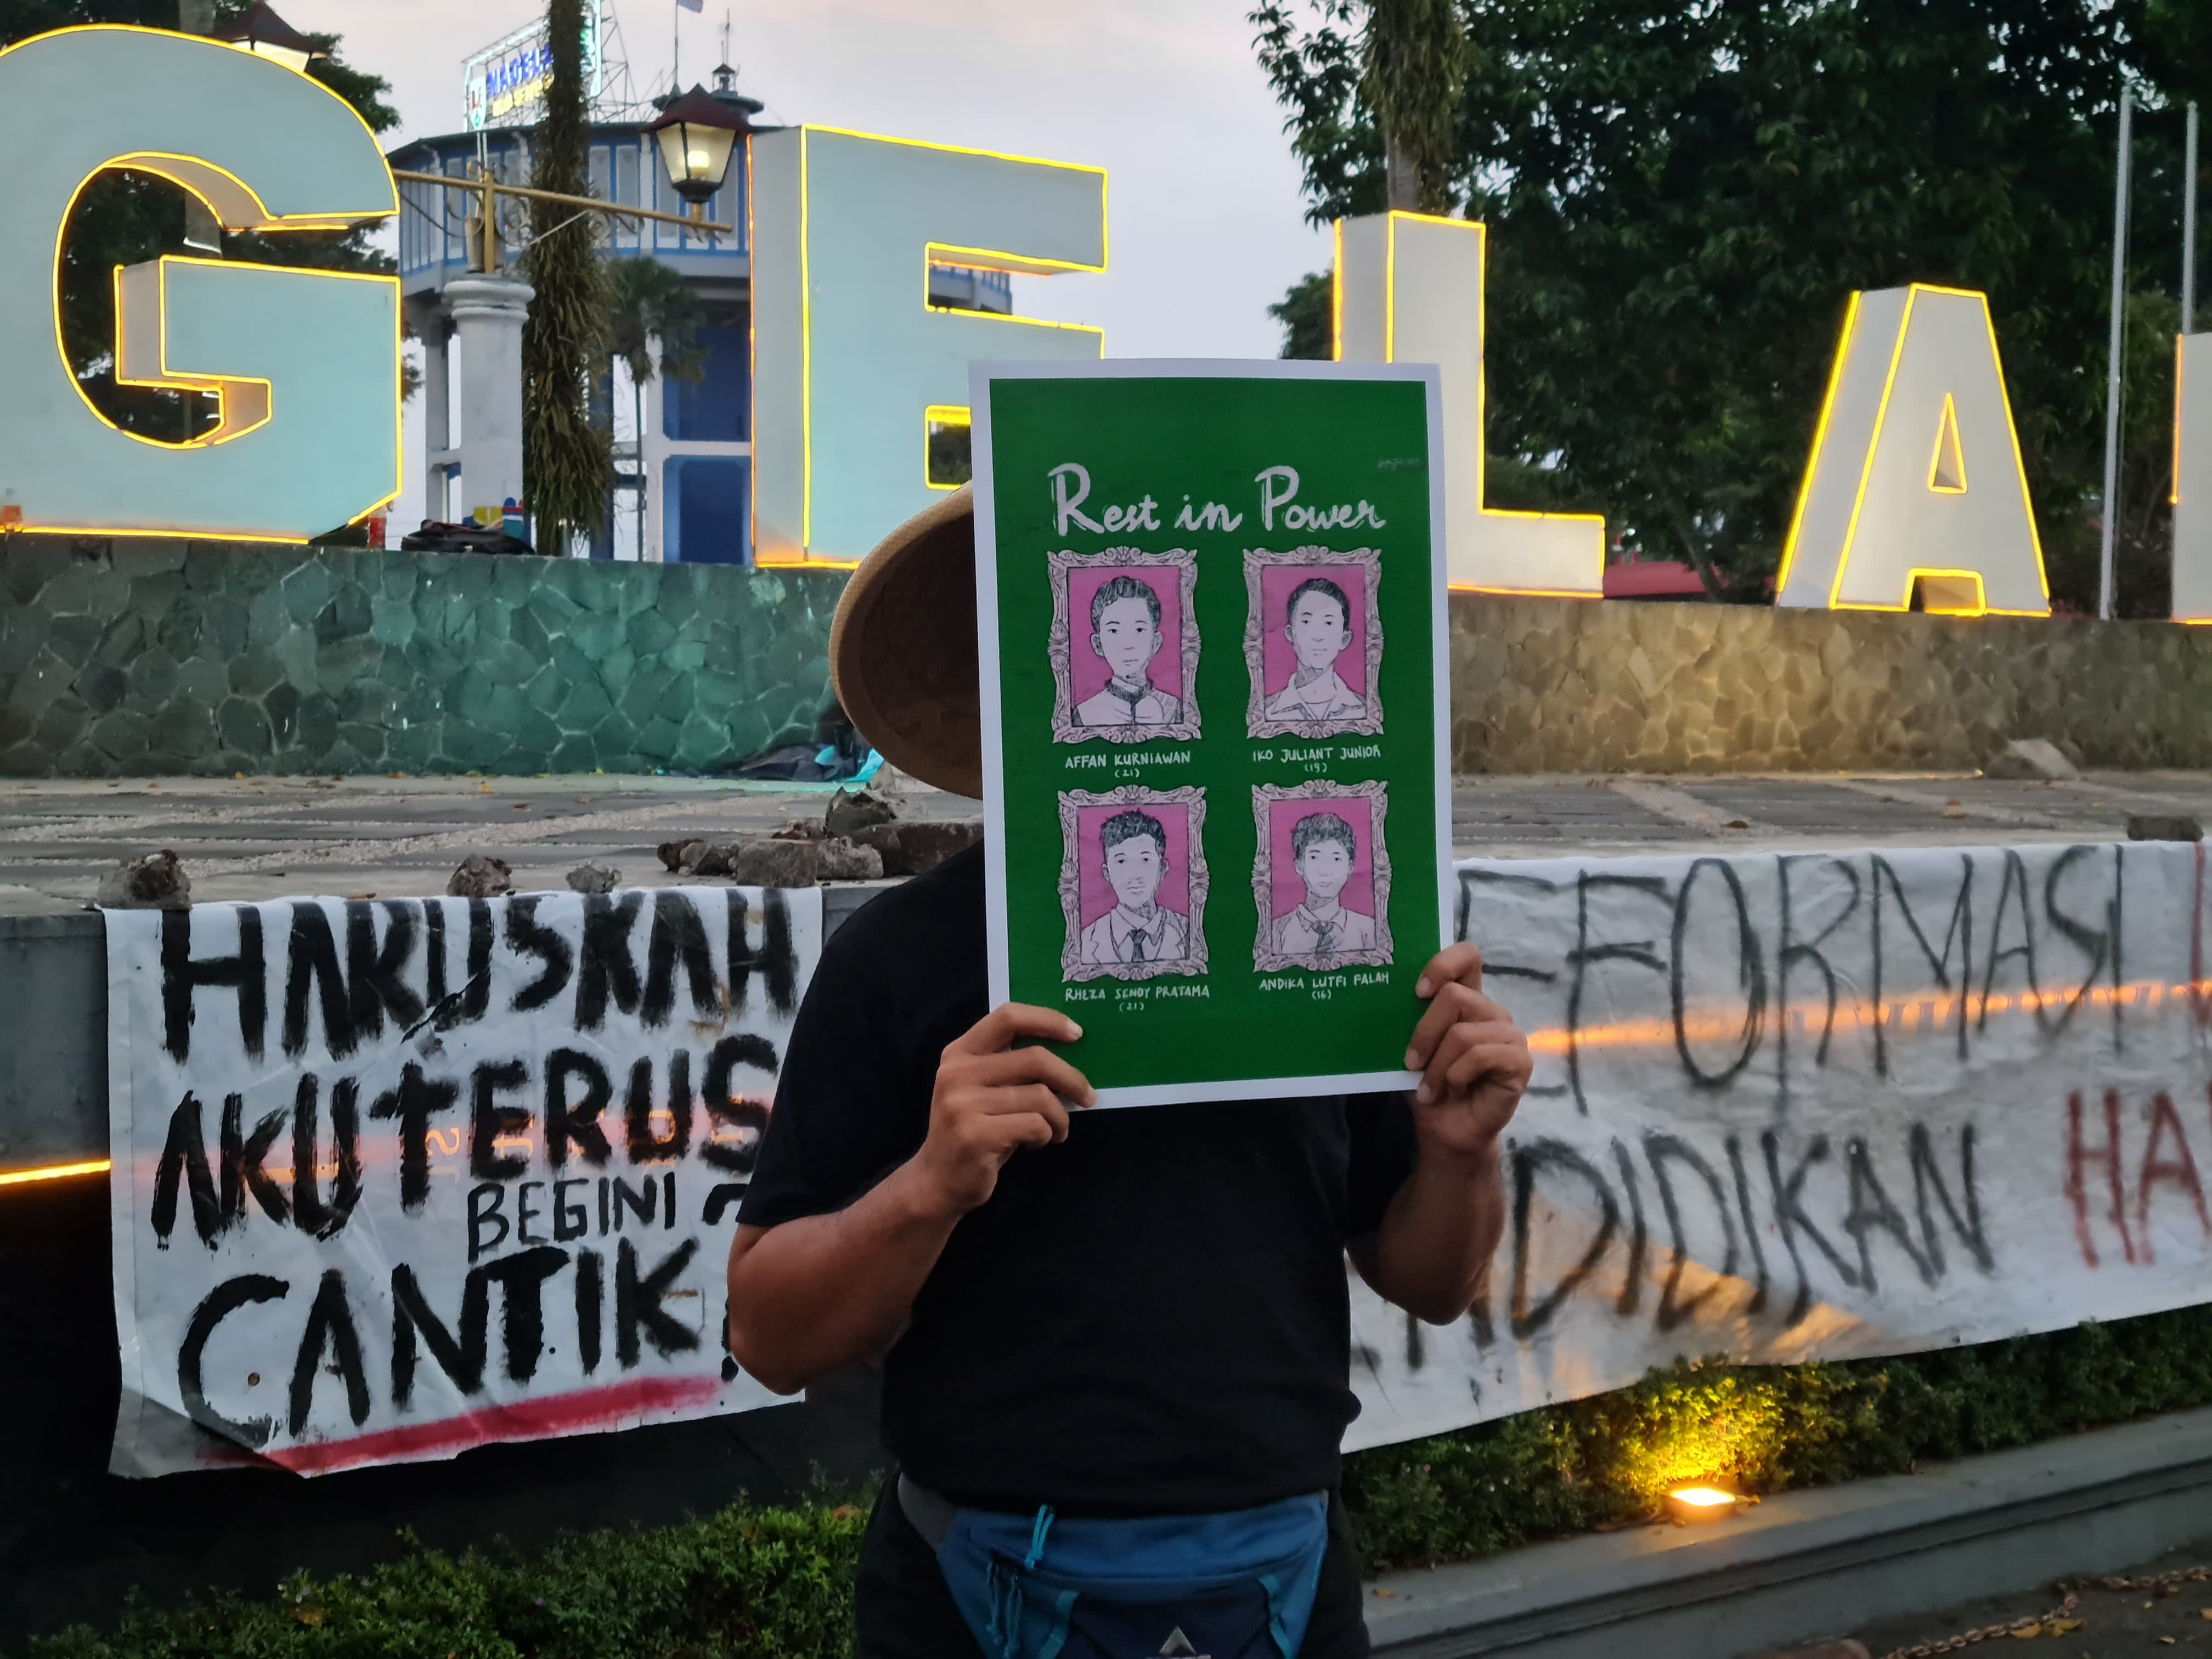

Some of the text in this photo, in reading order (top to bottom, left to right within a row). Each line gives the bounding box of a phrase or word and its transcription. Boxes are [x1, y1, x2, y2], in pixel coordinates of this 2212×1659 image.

[1048, 462, 1387, 537] Rest in Power
[1065, 751, 1190, 769] AFFAN KURNIAWAN
[1252, 744, 1381, 763] IKO JULIANT JUNIOR
[1114, 769, 1140, 778] (21)
[1259, 972, 1390, 991] ANDIKA LUTFI FALAH
[1457, 844, 2123, 1116] EFORMASI
[1065, 985, 1210, 1001] RHEZA SENDY PRATAMA
[1312, 989, 1332, 1000] (16)
[1119, 1002, 1144, 1012] (21)
[2066, 1081, 2212, 1271] HA
[467, 1172, 676, 1265] BEGINI
[177, 1237, 700, 1450] CANTIK
